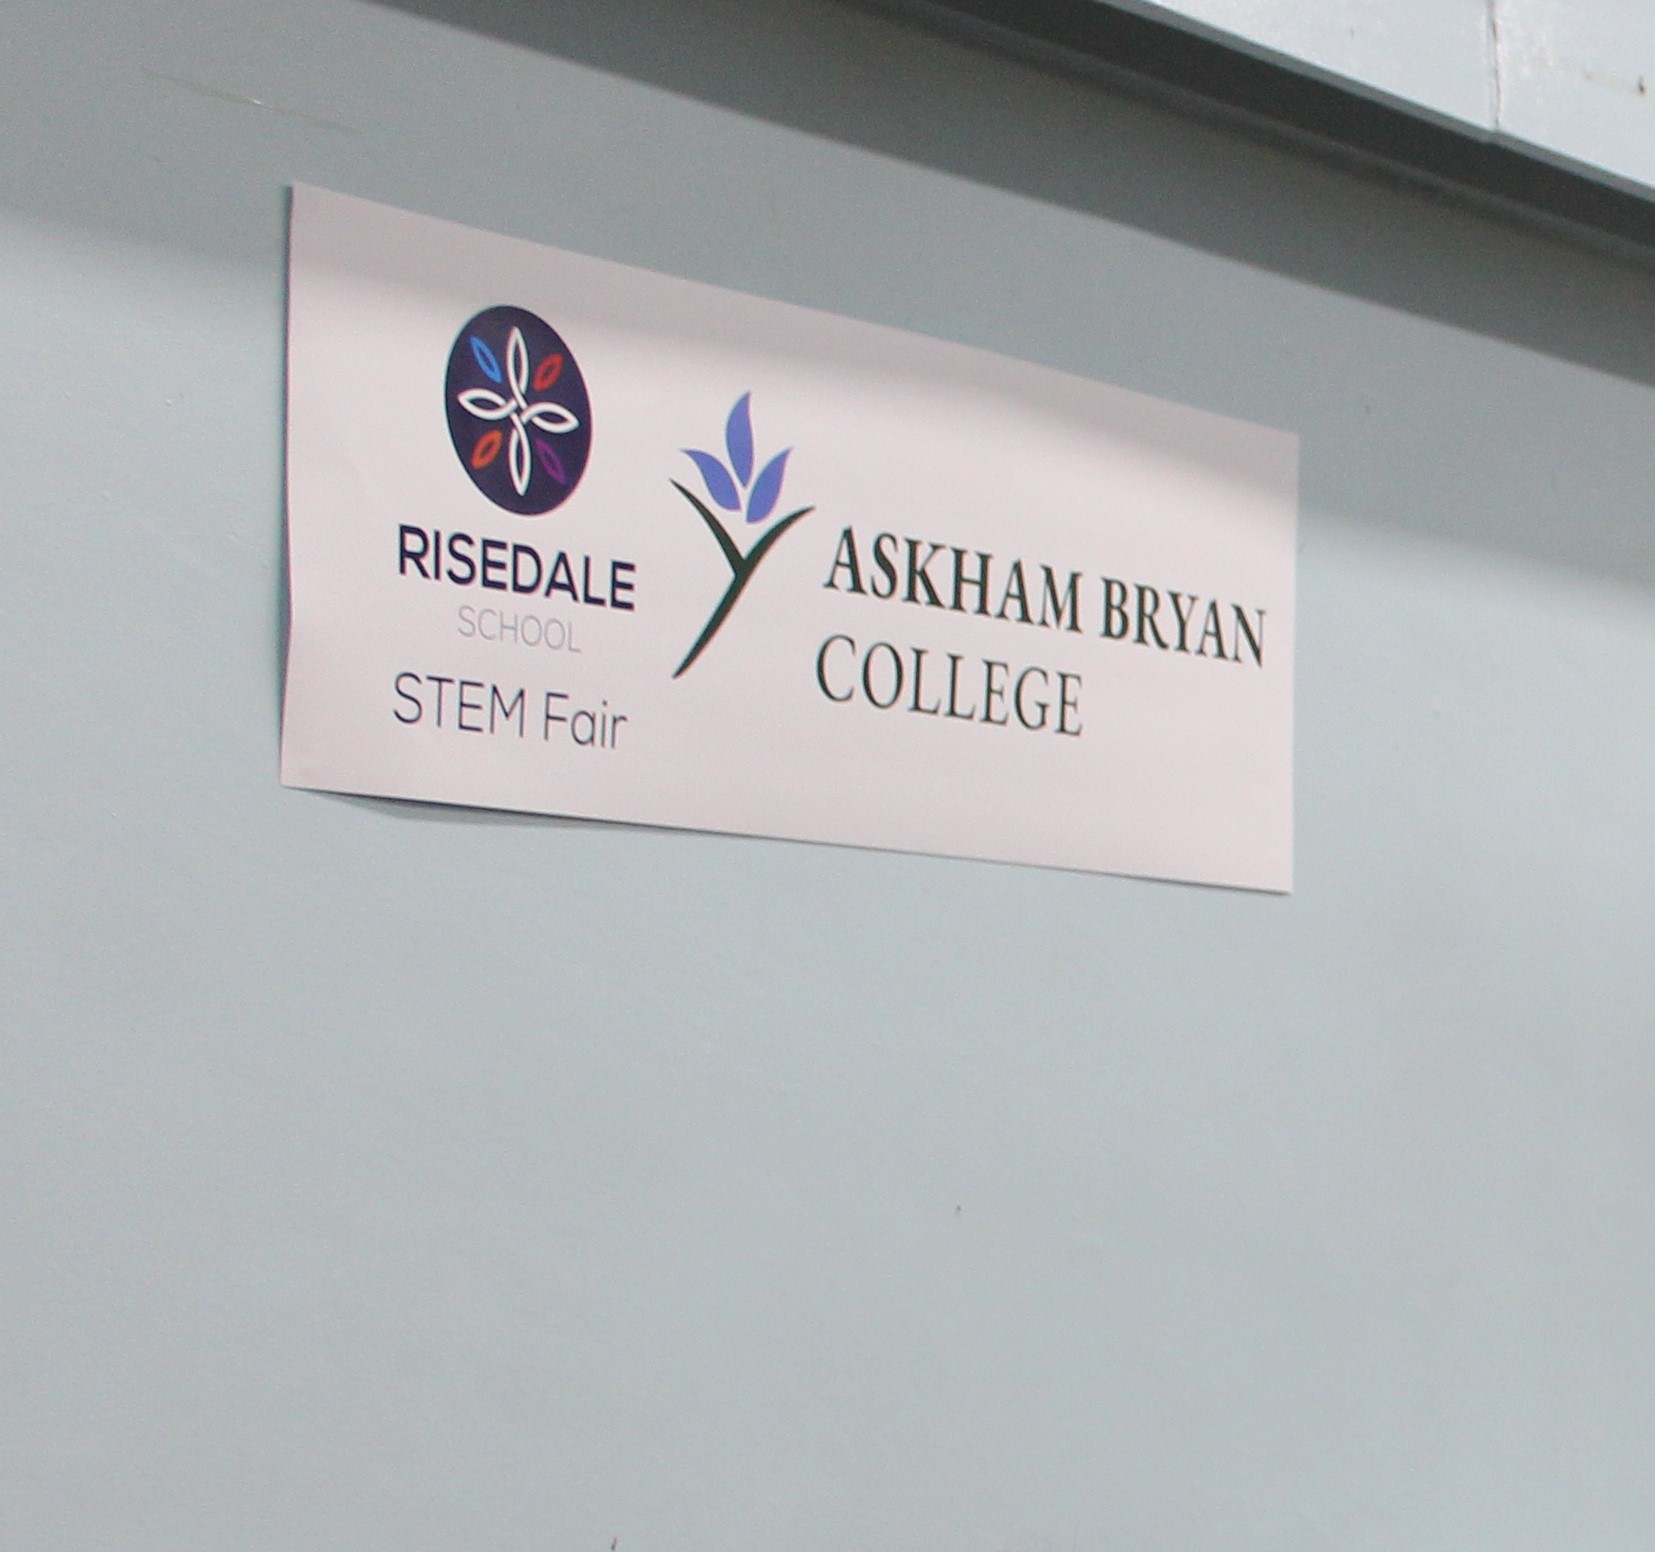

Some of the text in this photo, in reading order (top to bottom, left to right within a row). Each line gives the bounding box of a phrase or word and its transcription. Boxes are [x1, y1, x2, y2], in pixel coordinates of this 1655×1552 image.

[397, 522, 636, 613] RISEDALE
[823, 524, 1267, 668] ASKHAM BRYAN
[456, 604, 582, 655] SCHOOL
[391, 669, 628, 751] STEM Fair
[814, 633, 1084, 738] COLLEGE
